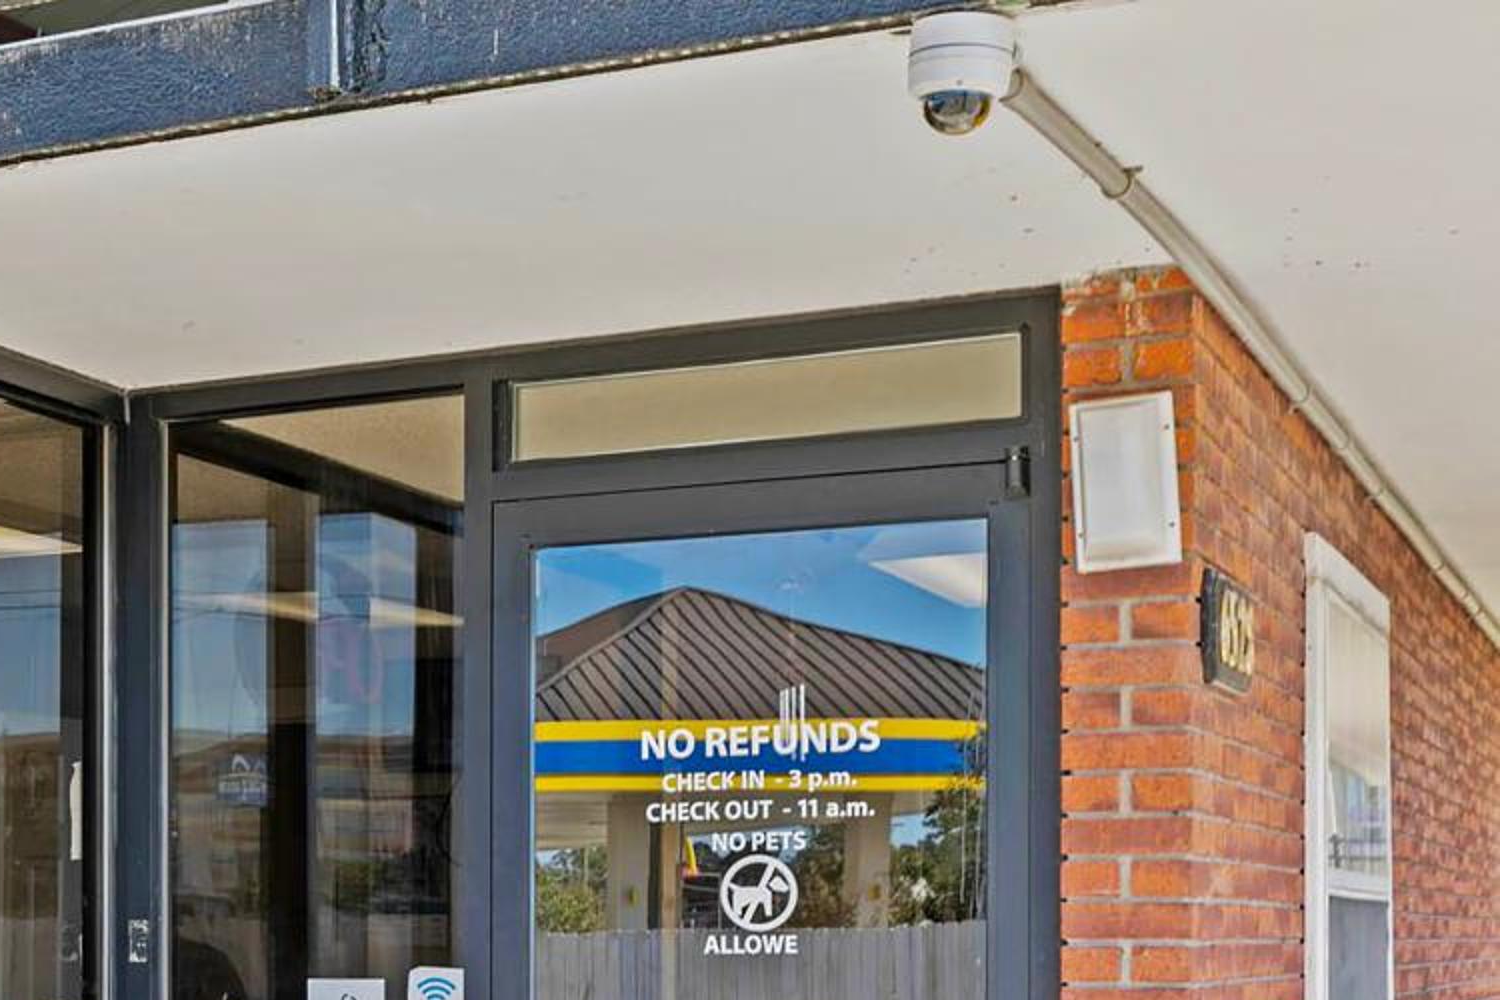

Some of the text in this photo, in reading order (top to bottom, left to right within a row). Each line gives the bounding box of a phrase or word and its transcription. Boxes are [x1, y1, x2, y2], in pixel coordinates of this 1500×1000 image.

[640, 719, 881, 760] NO REFUNDS
[662, 772, 734, 793] CHECK
[741, 772, 765, 790] IN
[789, 770, 800, 788] 3
[808, 768, 858, 792] p.m.
[646, 801, 719, 823] CHECK
[725, 800, 772, 820] OUT
[798, 799, 819, 818] 11
[826, 799, 875, 817] a.m.
[711, 830, 806, 851] NO PETS
[703, 934, 798, 955] ALLOWE
